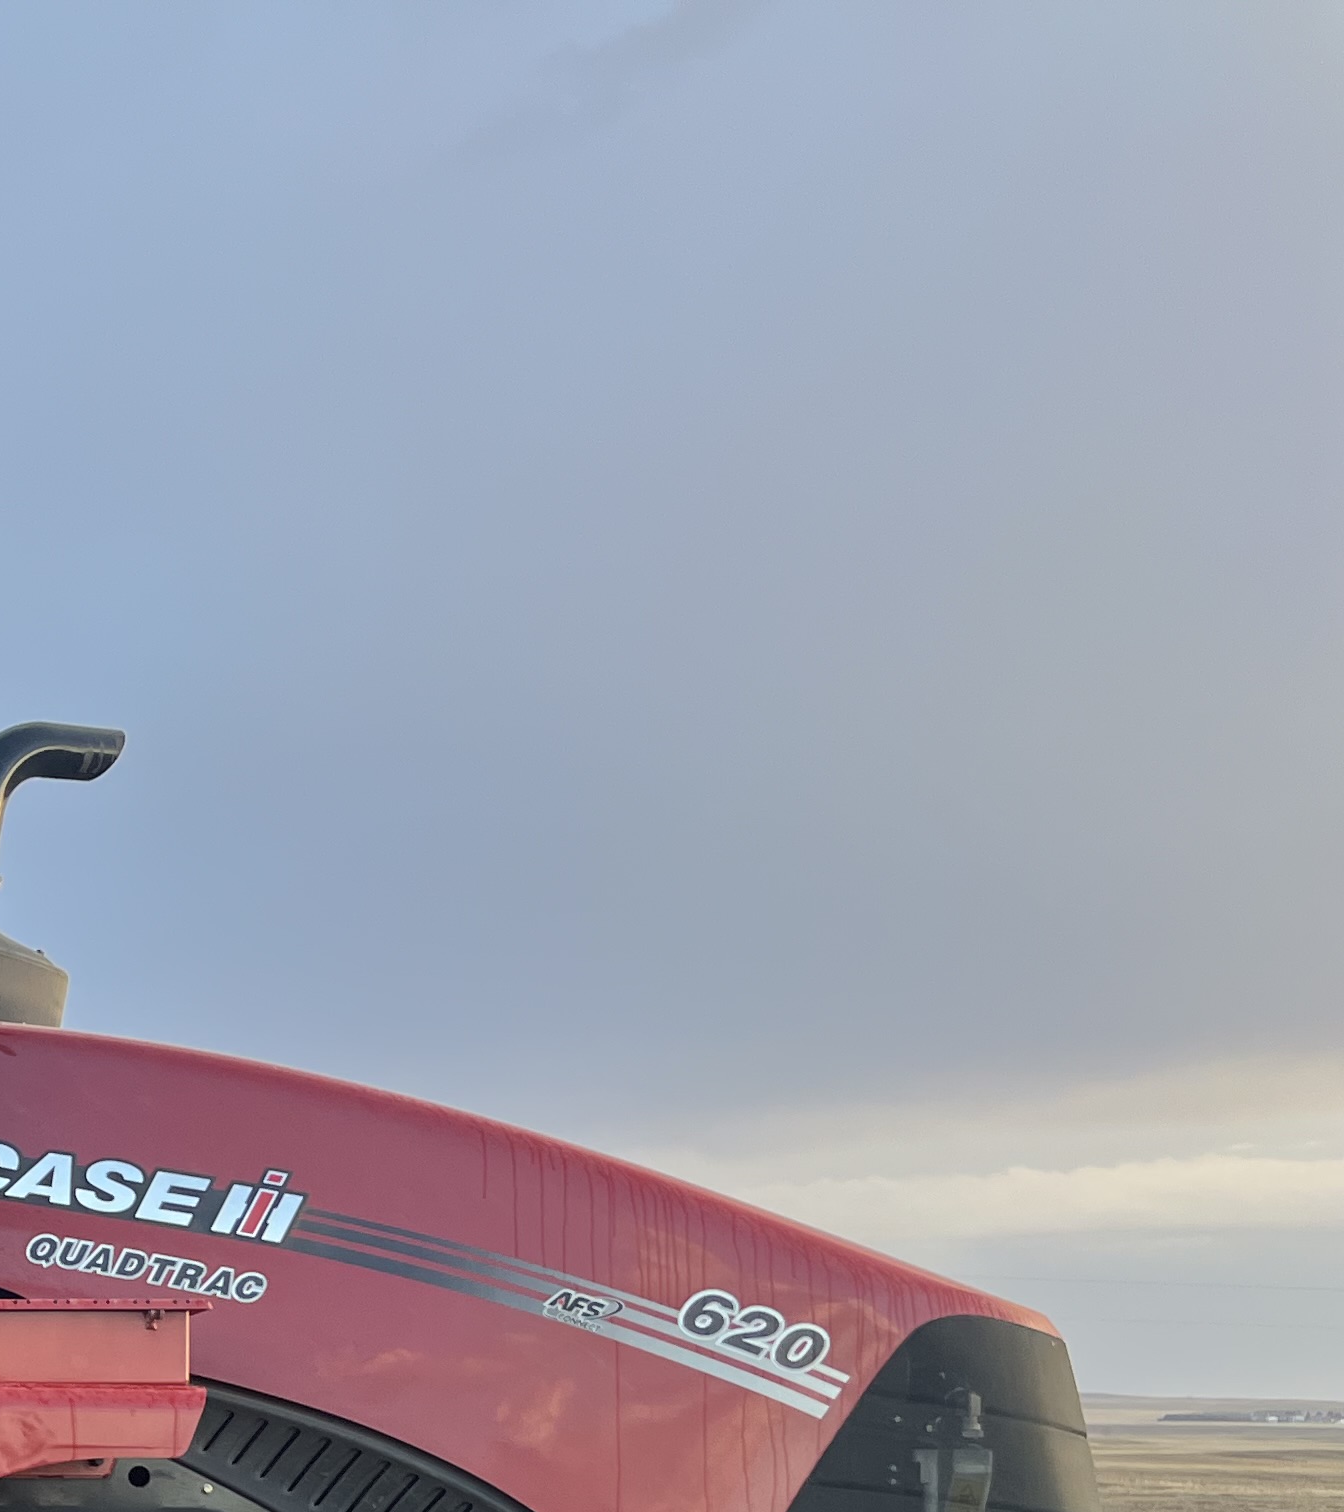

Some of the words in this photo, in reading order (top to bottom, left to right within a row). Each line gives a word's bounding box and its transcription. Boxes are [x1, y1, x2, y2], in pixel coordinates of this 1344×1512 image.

[26, 1233, 268, 1302] QUADTRAC
[543, 1289, 610, 1317] AFS
[678, 1289, 831, 1374] 620
